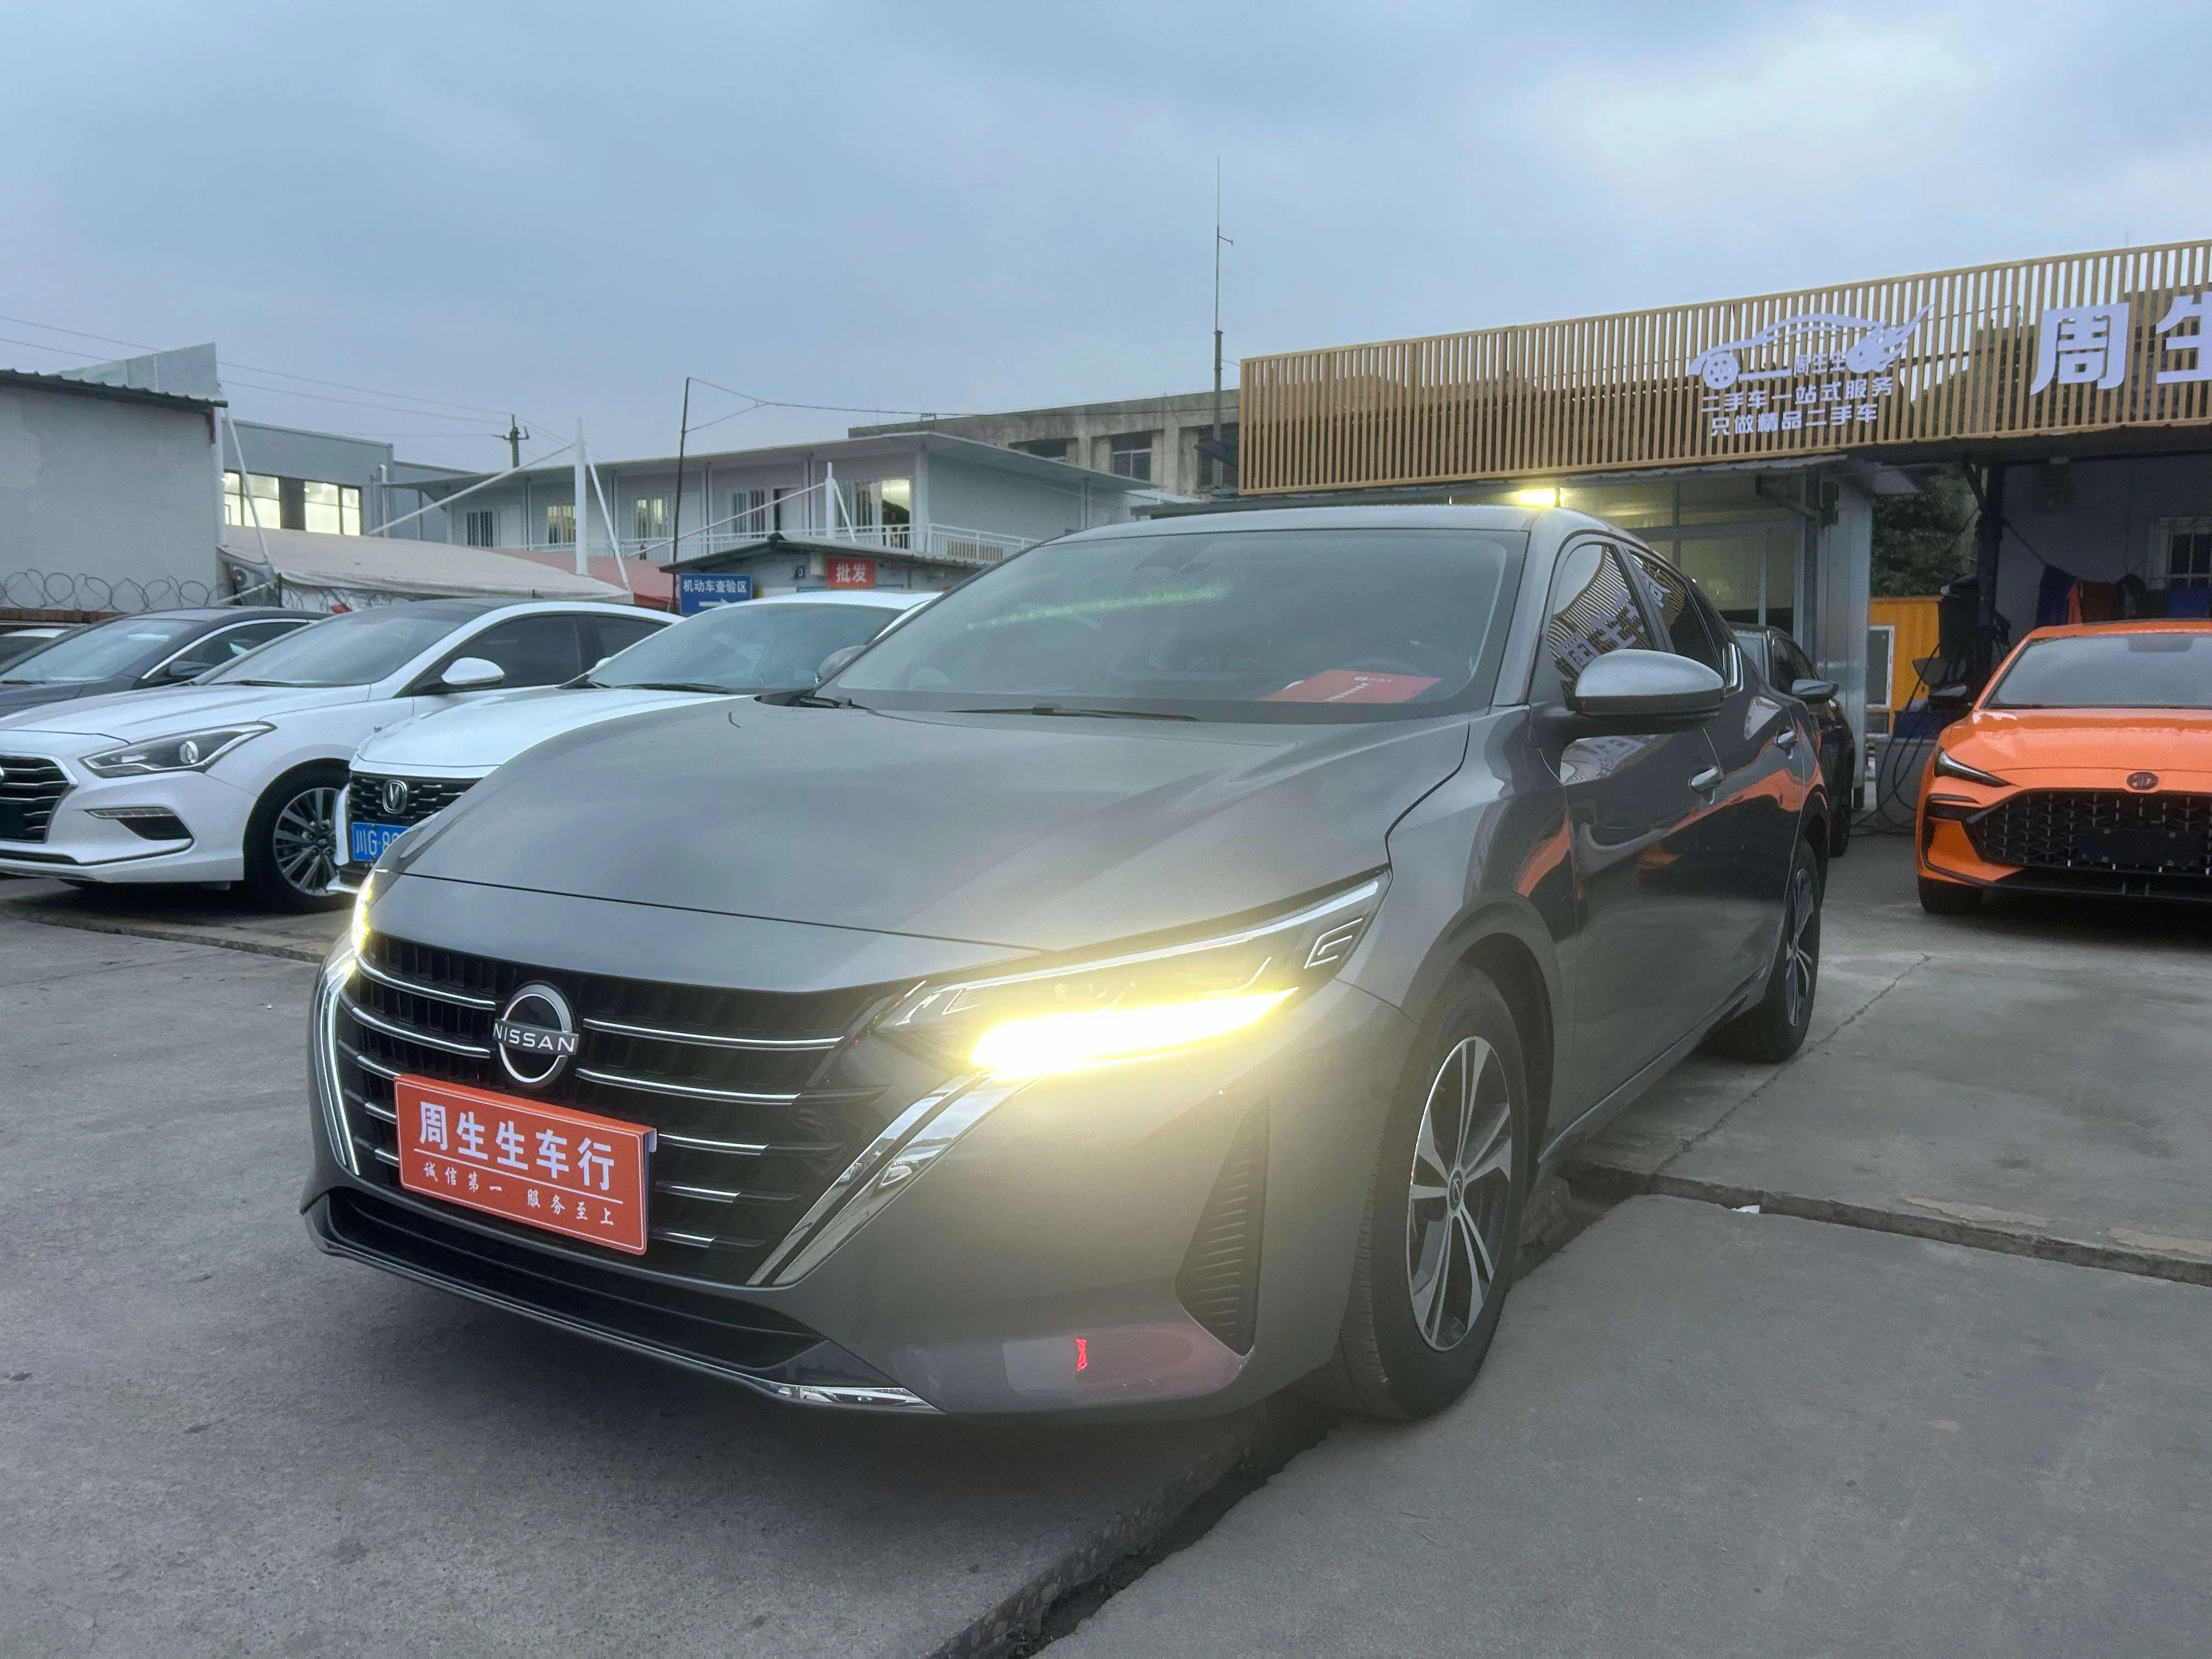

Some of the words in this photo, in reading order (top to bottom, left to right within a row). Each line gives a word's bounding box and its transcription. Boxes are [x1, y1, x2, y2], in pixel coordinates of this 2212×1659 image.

[1701, 376, 1893, 412] 二手车一站式服务
[1711, 403, 1878, 437] 只做精品二手车
[683, 579, 747, 593] 机动车查验区
[836, 562, 867, 583] 批发
[494, 1023, 575, 1052] NISSAN
[419, 1101, 614, 1190] 周生生车行
[423, 1161, 503, 1193] 诚信第一
[527, 1189, 614, 1226] 服务至上
